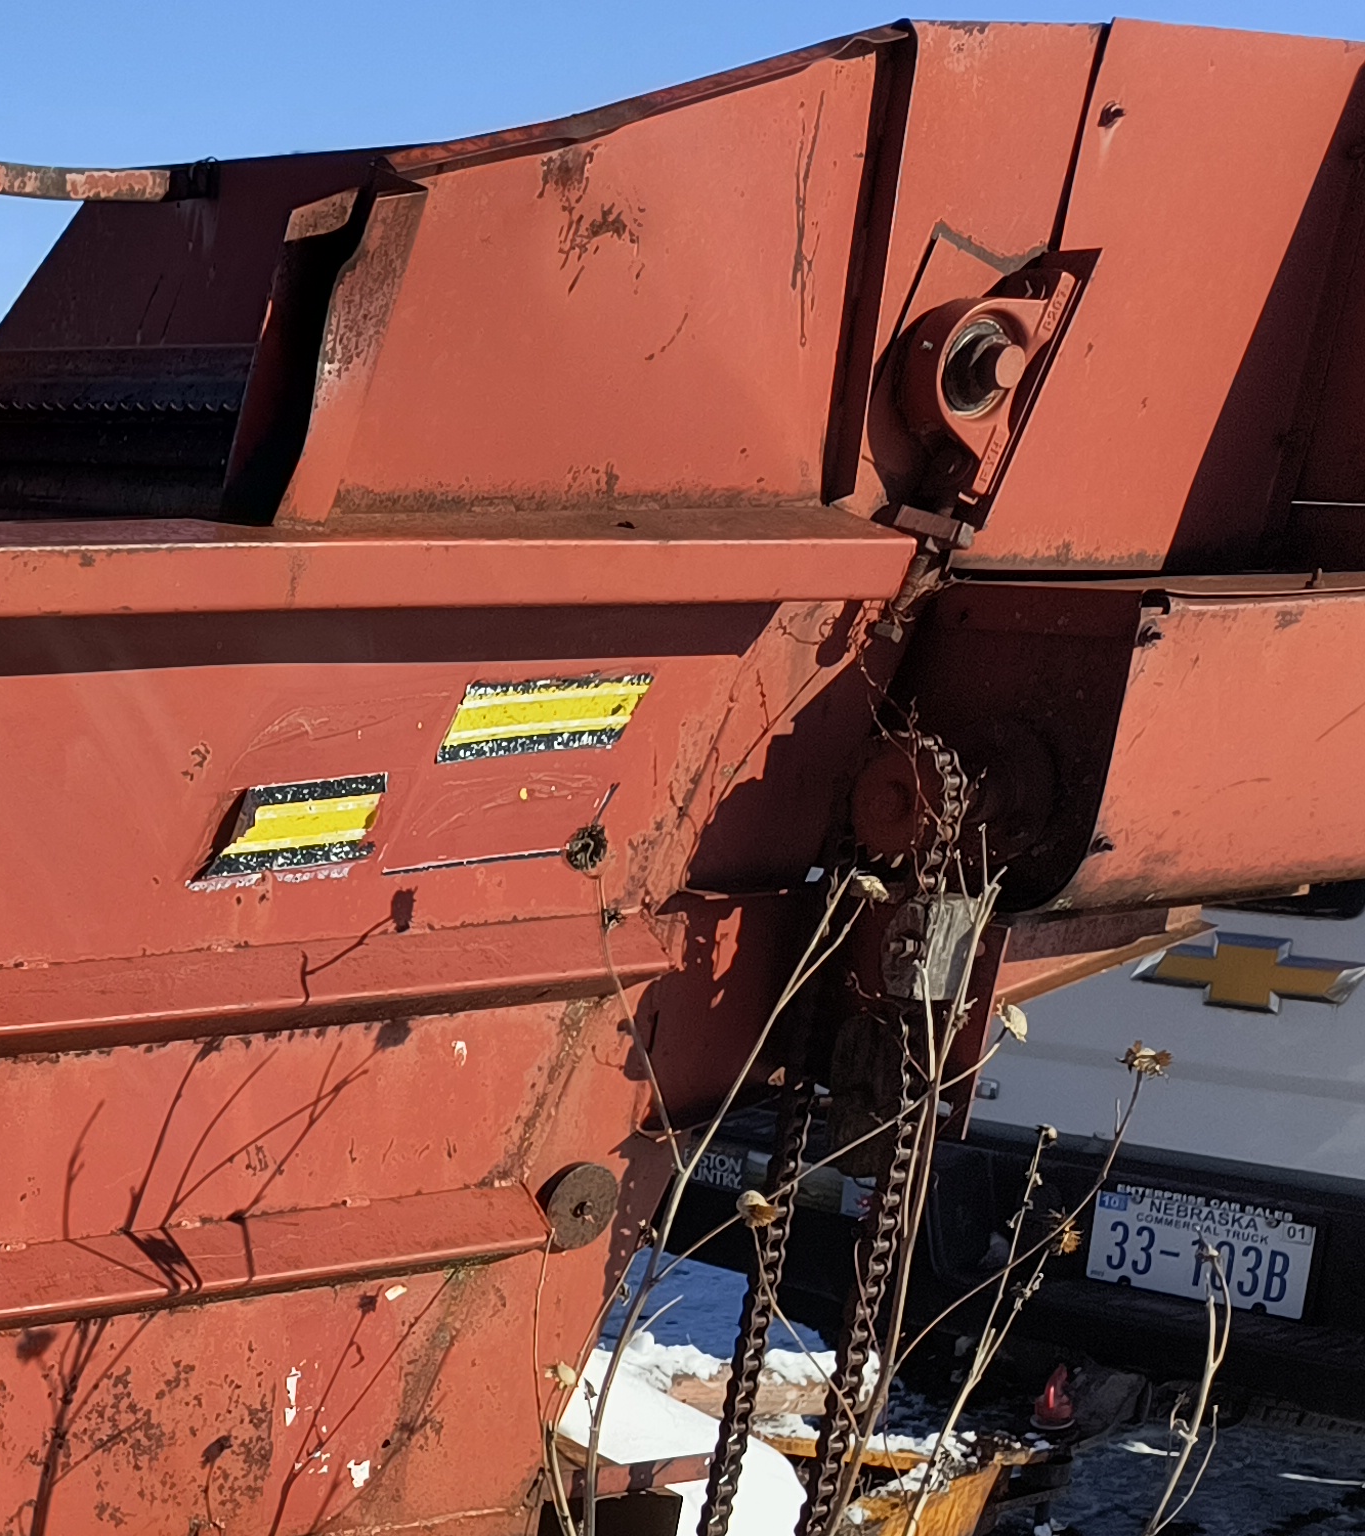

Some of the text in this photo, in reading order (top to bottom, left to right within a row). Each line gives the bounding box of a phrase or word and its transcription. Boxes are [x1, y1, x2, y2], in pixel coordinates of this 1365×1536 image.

[691, 1166, 742, 1190] UNTRY
[1116, 1184, 1293, 1222] ENTERPRISE CAR SALES
[1149, 1200, 1259, 1233] NEBRASKA
[1136, 1212, 1270, 1246] COMMERCIAL TRUCK
[1286, 1225, 1306, 1240] 01
[1106, 1220, 1290, 1303] 33-103B
